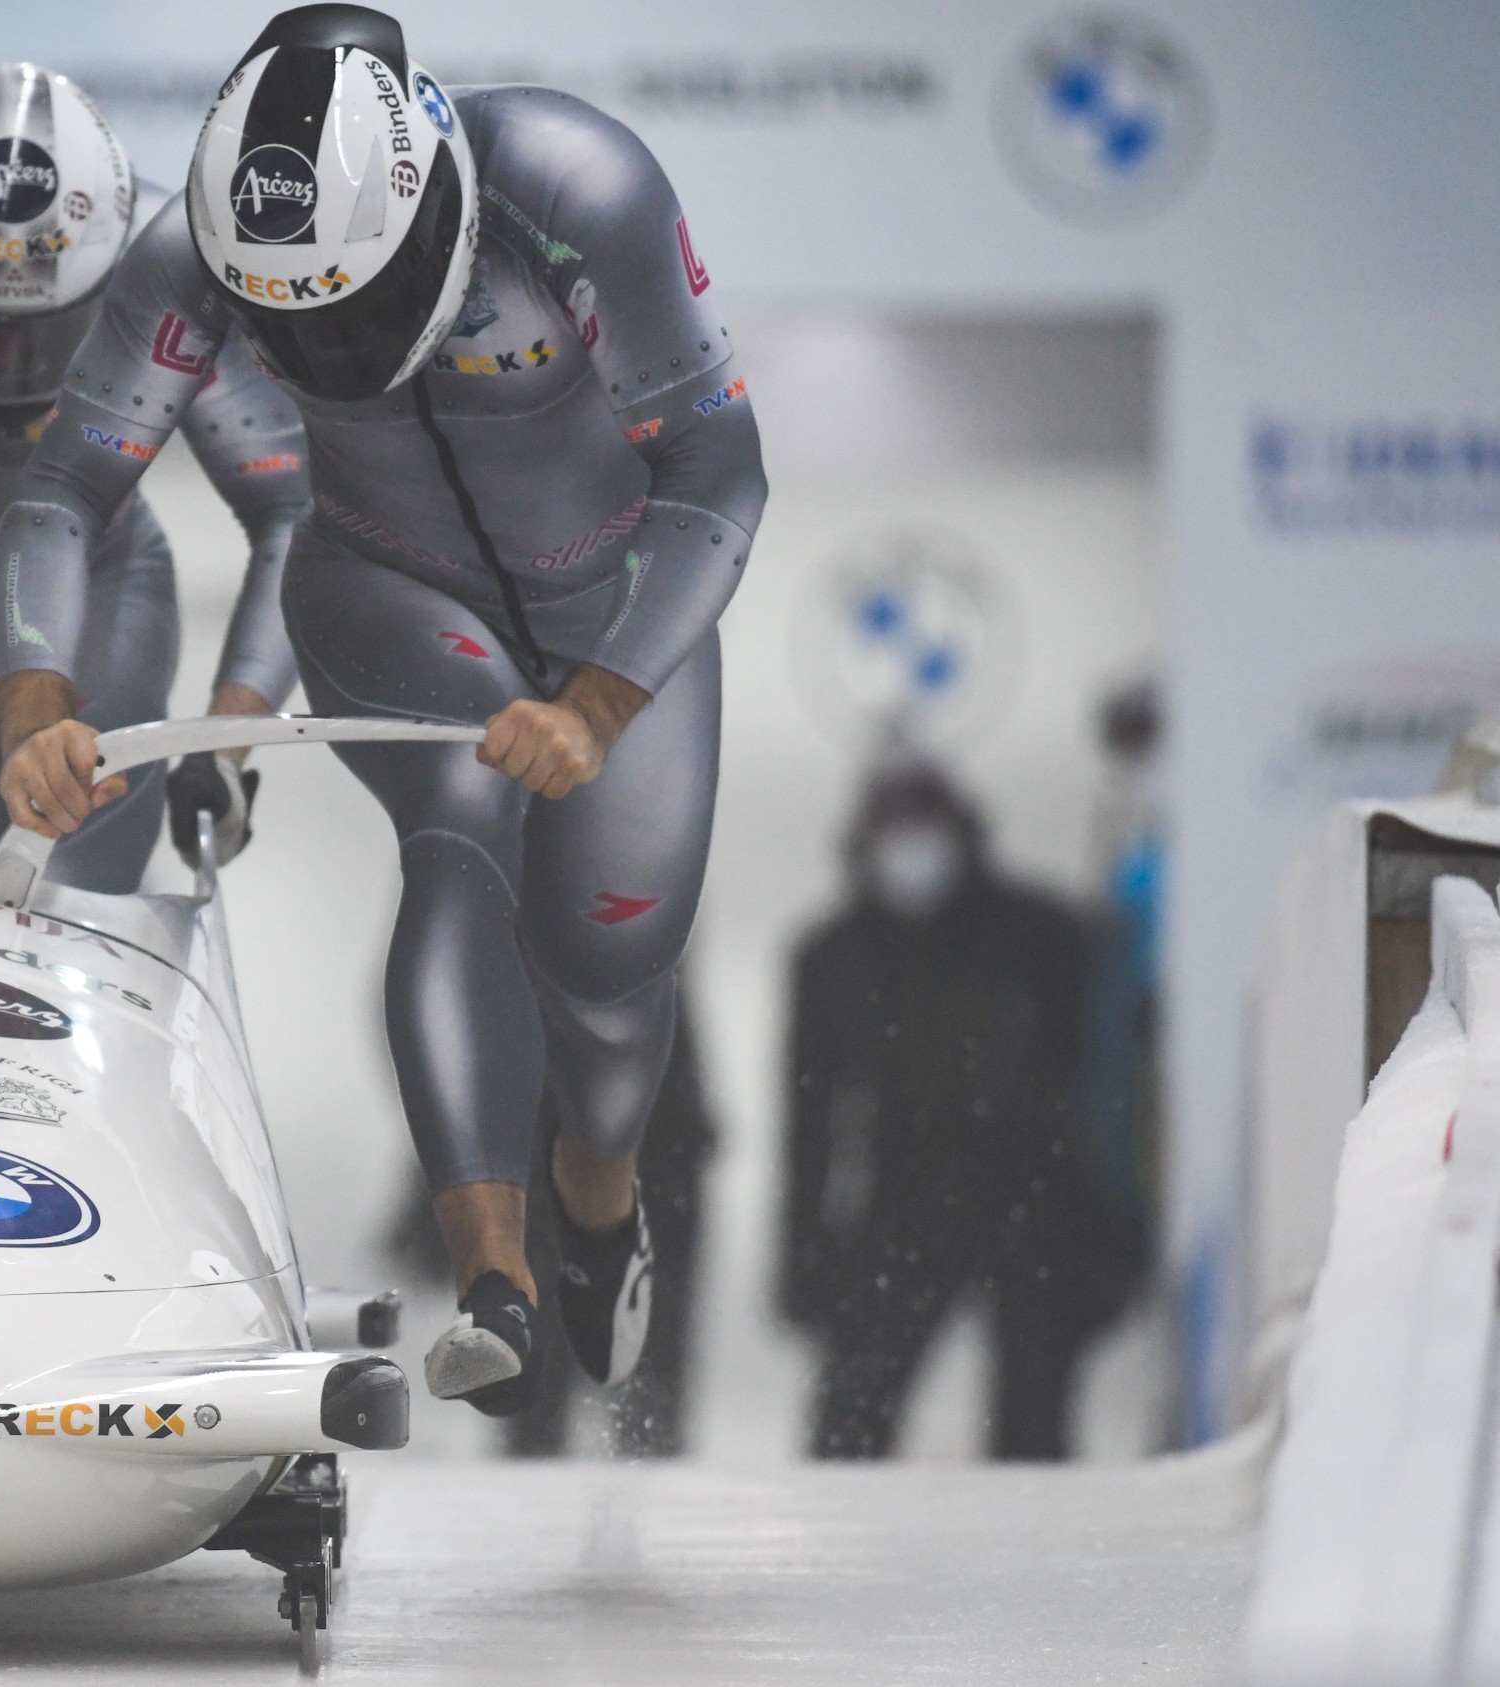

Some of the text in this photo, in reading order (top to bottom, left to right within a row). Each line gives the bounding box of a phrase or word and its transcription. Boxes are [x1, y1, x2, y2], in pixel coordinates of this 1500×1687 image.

[365, 60, 412, 154] Binders
[224, 261, 321, 301] RECK
[18, 1064, 85, 1096] RIGA
